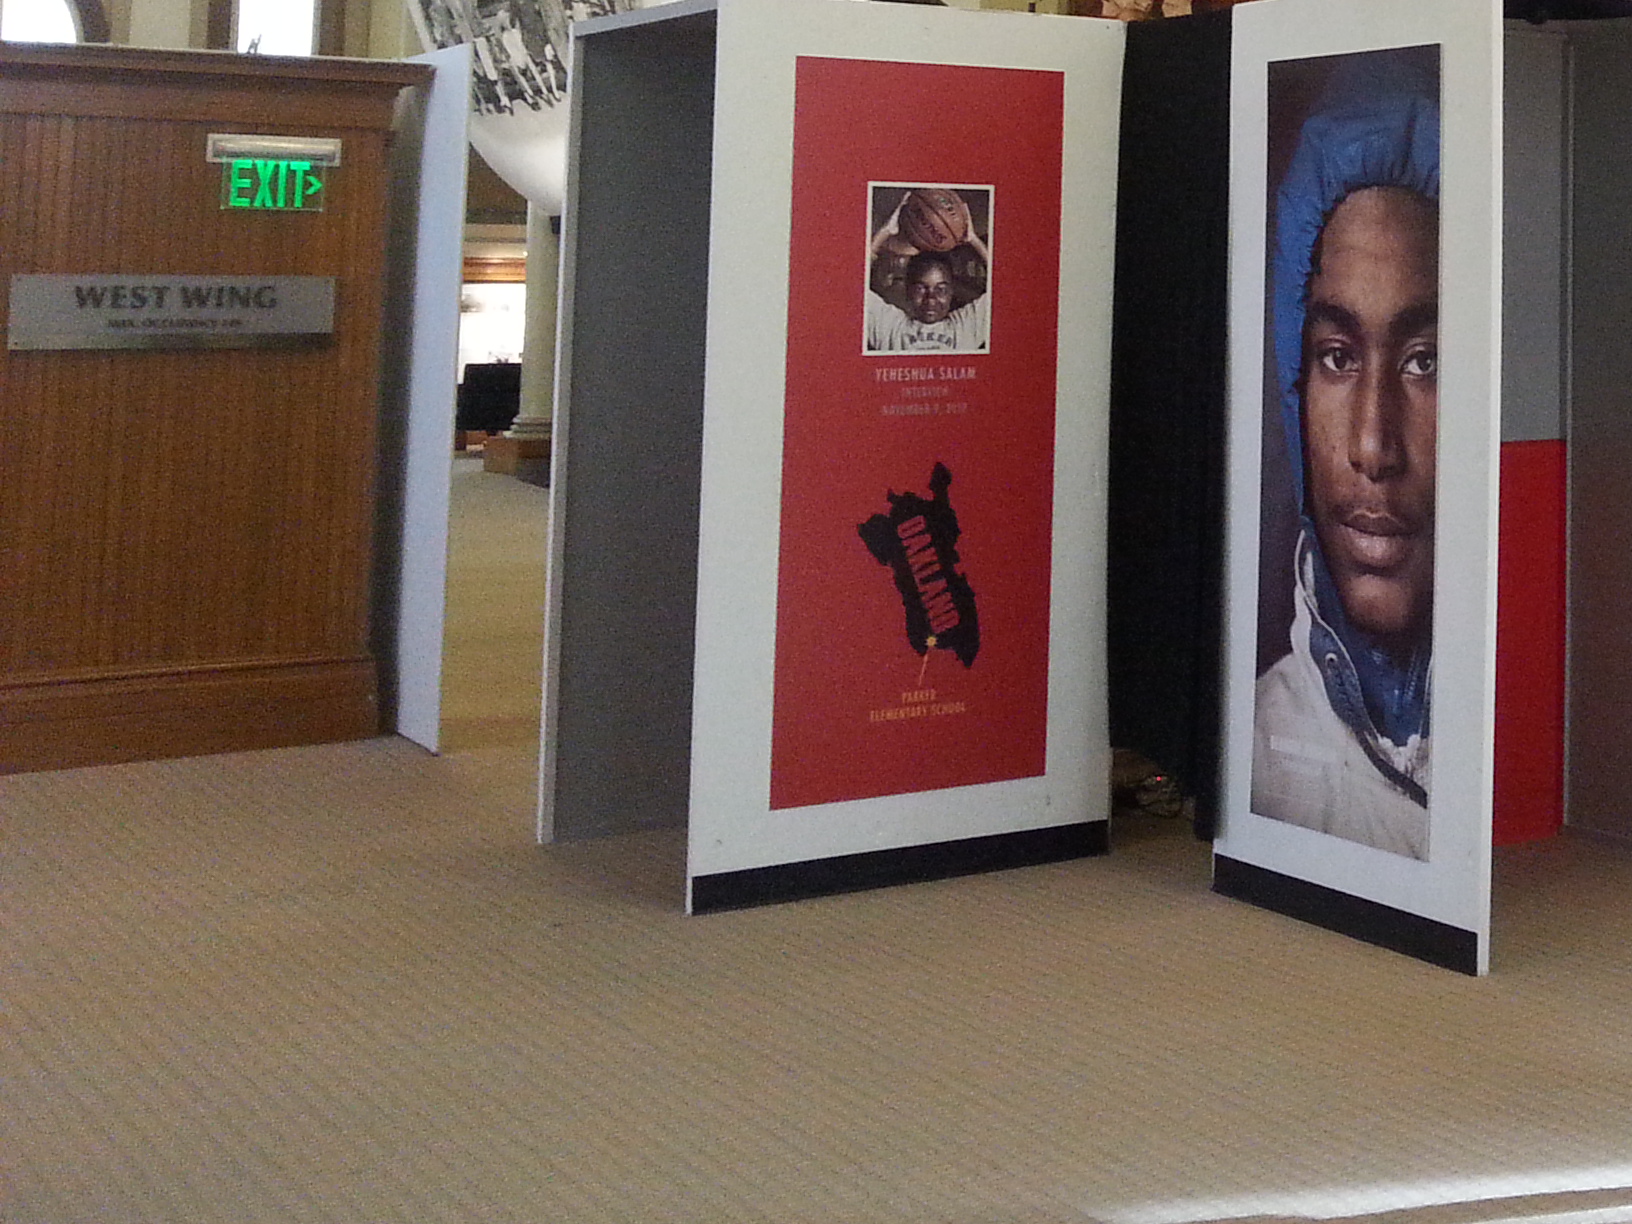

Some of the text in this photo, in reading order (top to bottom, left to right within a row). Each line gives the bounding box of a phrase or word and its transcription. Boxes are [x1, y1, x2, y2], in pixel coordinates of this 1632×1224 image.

[229, 159, 312, 208] EXIT
[74, 284, 278, 309] WEST WING
[875, 366, 977, 382] YEHESHUA SALAM
[897, 514, 961, 635] OAKLAND
[902, 688, 937, 704] PARKER
[869, 701, 967, 722] ELEMENTARY SCHOOL
